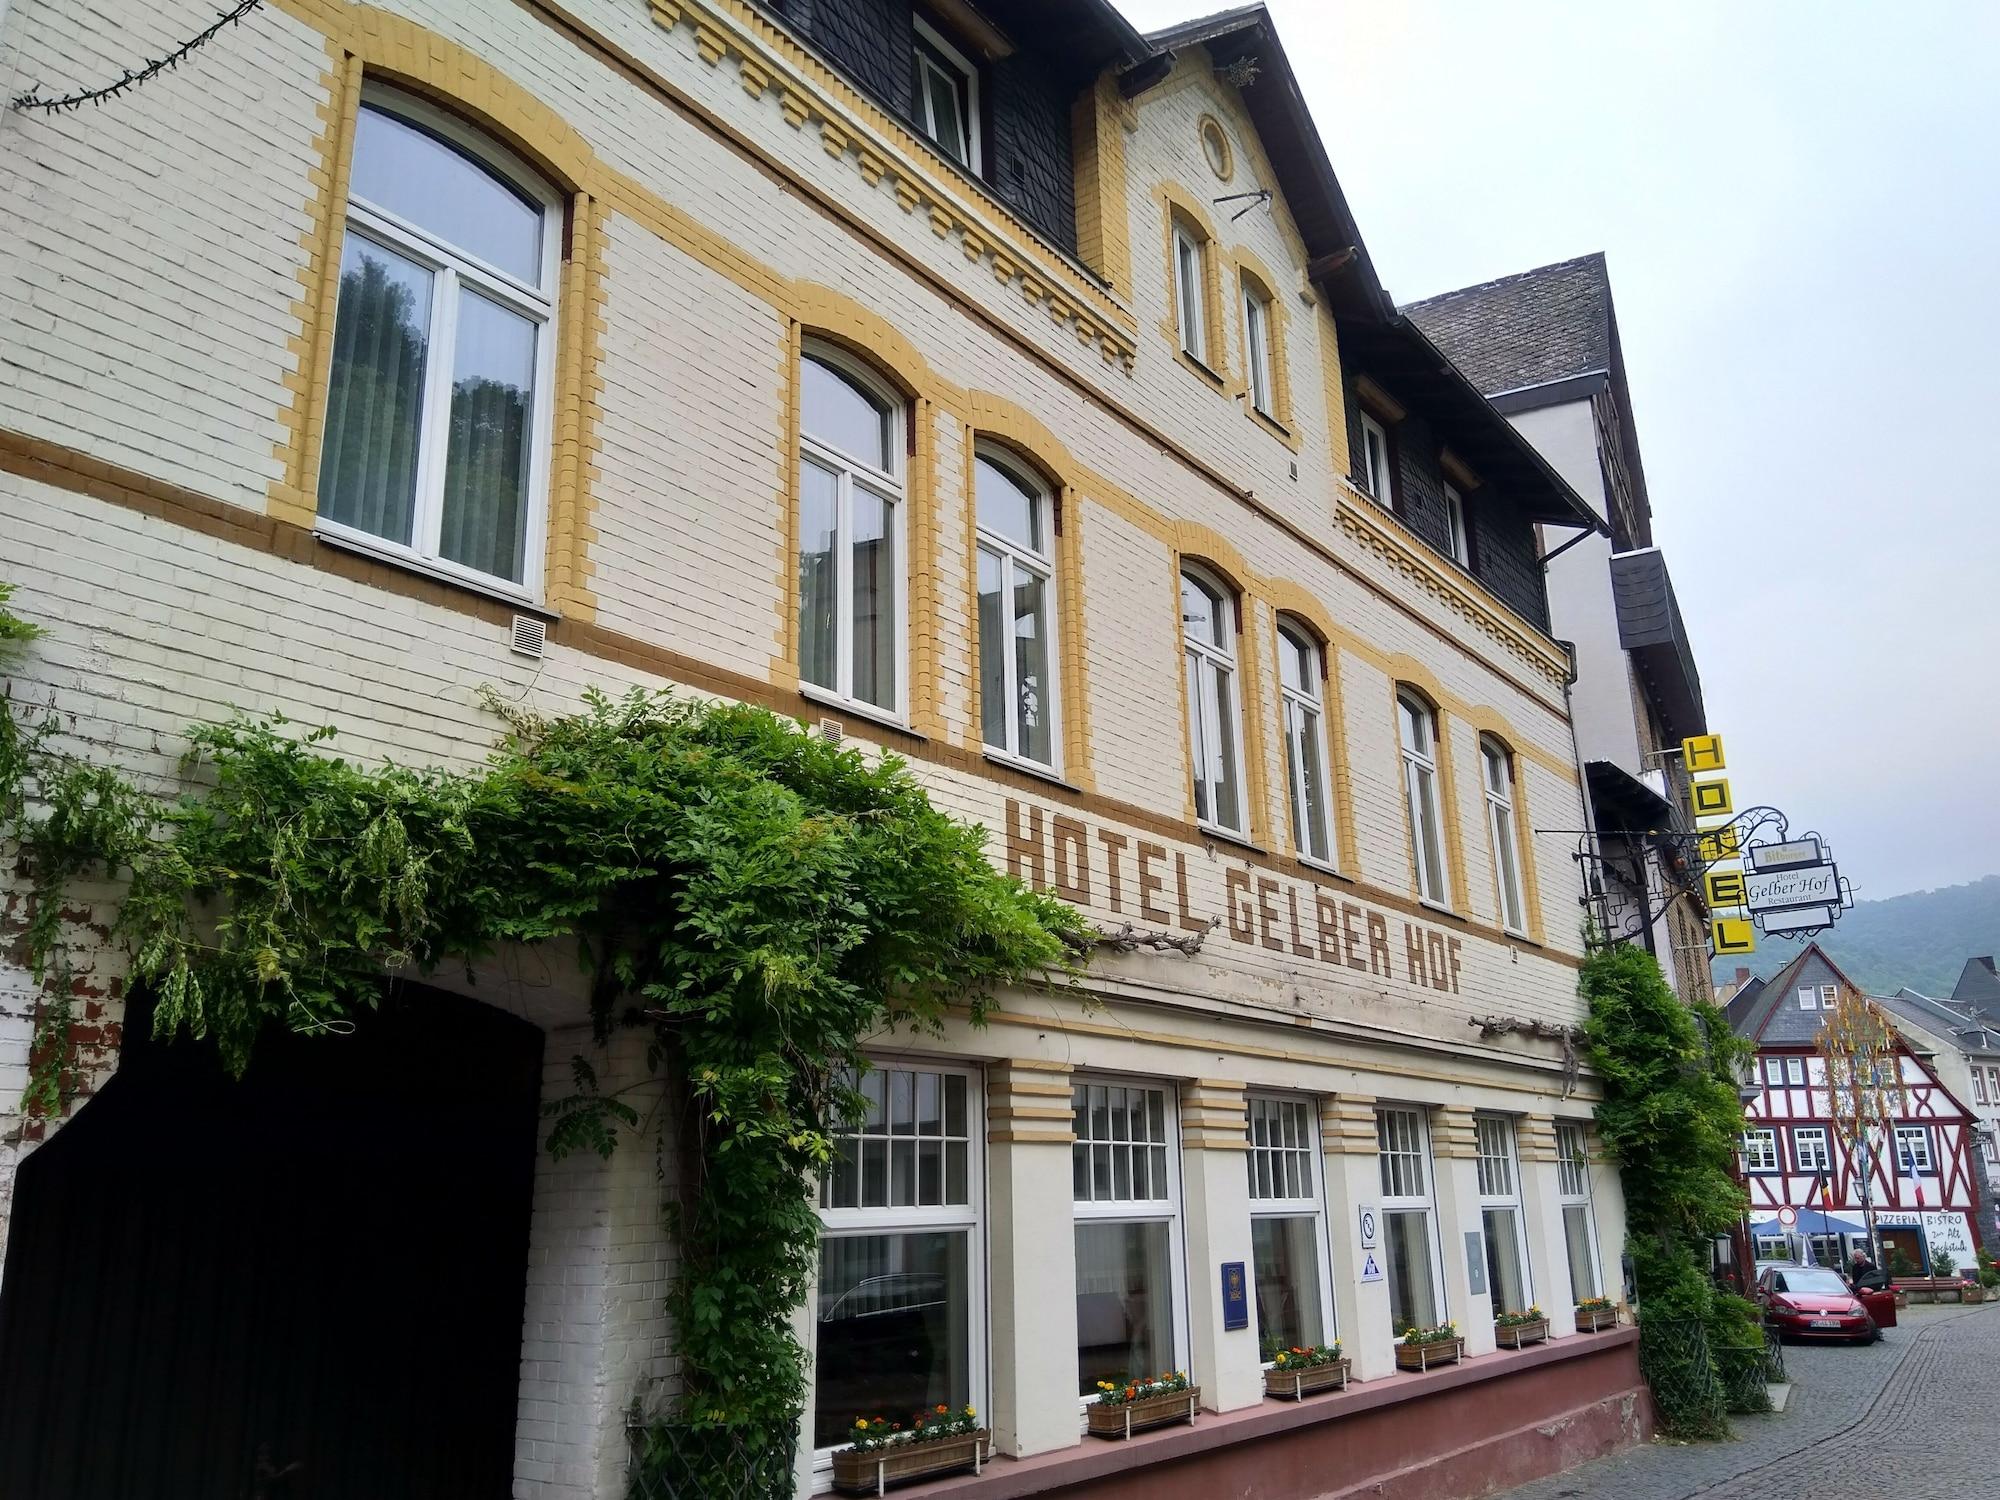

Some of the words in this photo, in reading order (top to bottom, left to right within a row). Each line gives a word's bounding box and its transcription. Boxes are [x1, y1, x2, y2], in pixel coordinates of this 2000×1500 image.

[1688, 737, 1749, 949] HOTEL
[1776, 872, 1799, 882] Hotel
[1005, 798, 1209, 932] HOTEL
[1226, 866, 1392, 979] GELBER
[1404, 922, 1462, 994] HOF
[1749, 880, 1796, 902] Gelber
[1800, 873, 1831, 894] Hof
[1768, 893, 1812, 905] Restaurant
[1875, 1214, 1918, 1224] PIZZERIA
